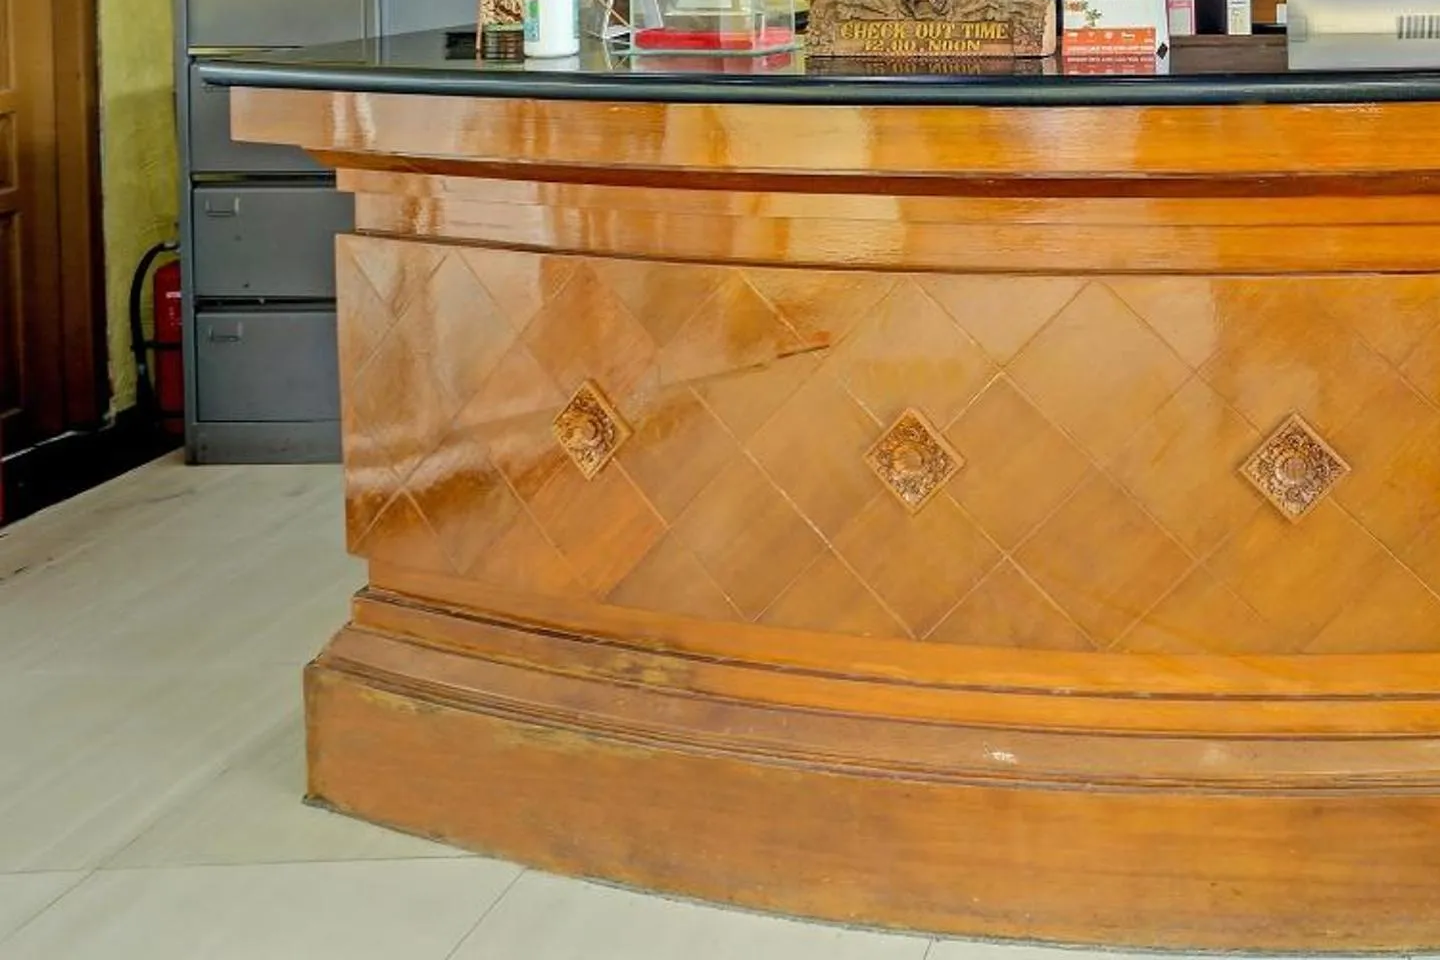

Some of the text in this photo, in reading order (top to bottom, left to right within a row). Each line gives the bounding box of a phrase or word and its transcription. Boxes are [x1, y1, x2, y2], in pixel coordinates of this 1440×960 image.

[840, 21, 1009, 39] CHECK OUT TIME
